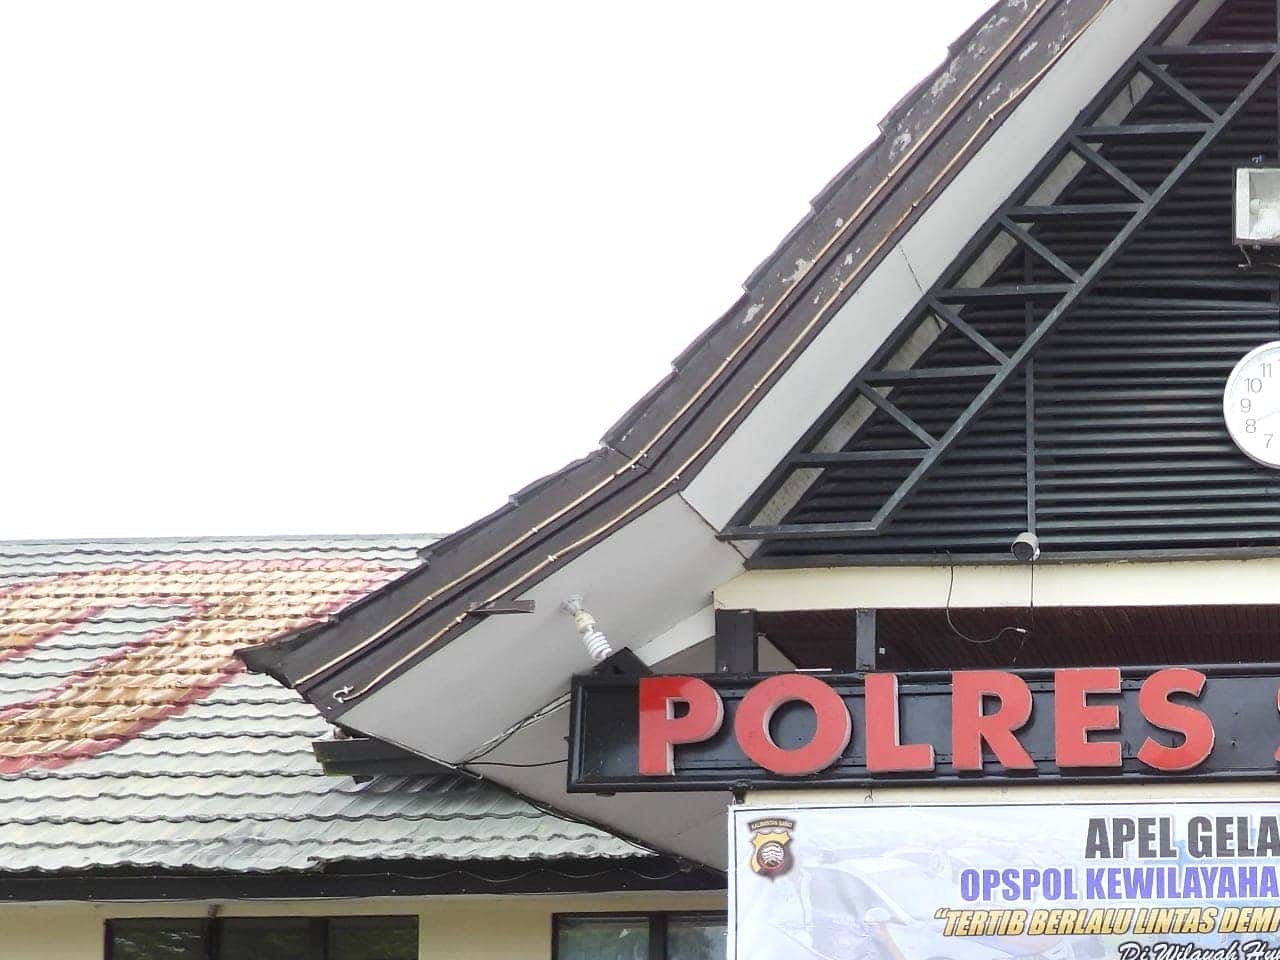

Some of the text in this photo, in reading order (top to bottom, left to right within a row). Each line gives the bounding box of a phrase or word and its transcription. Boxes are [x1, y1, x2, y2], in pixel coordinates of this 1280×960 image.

[1260, 362, 1272, 378] 11
[1244, 377, 1262, 393] 10
[1240, 398, 1251, 413] 9
[1245, 418, 1257, 433] 8
[1264, 433, 1274, 448] 7
[638, 667, 1216, 776] POLRES
[1084, 817, 1178, 859] APEL
[960, 868, 1078, 901] OPSPOL
[1027, 908, 1135, 936] BERLALU
[1133, 907, 1218, 934] LINTAS
